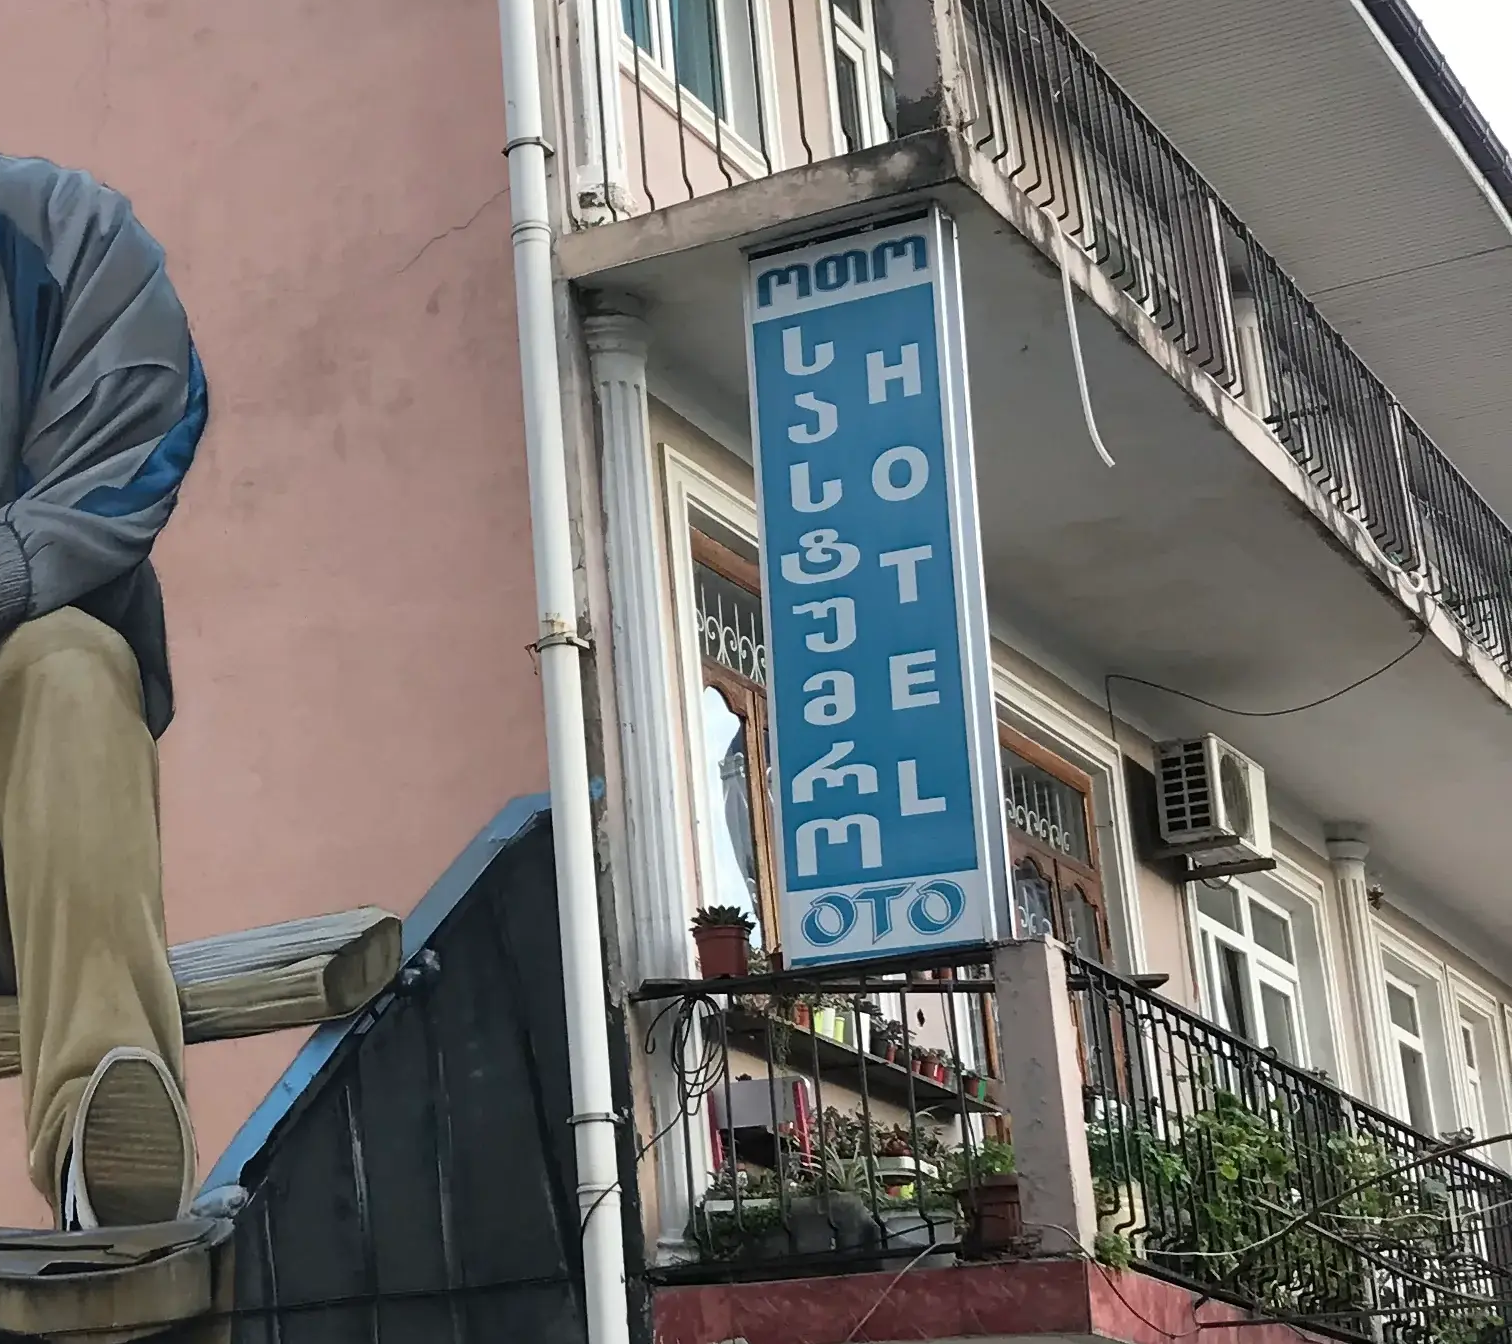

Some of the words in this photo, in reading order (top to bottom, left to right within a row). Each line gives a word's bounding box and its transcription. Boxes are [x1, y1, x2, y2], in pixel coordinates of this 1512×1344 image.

[757, 234, 928, 309] ოთო
[780, 326, 883, 877] სასტუმრო
[866, 342, 947, 817] HOTEL
[801, 879, 966, 947] OTO
